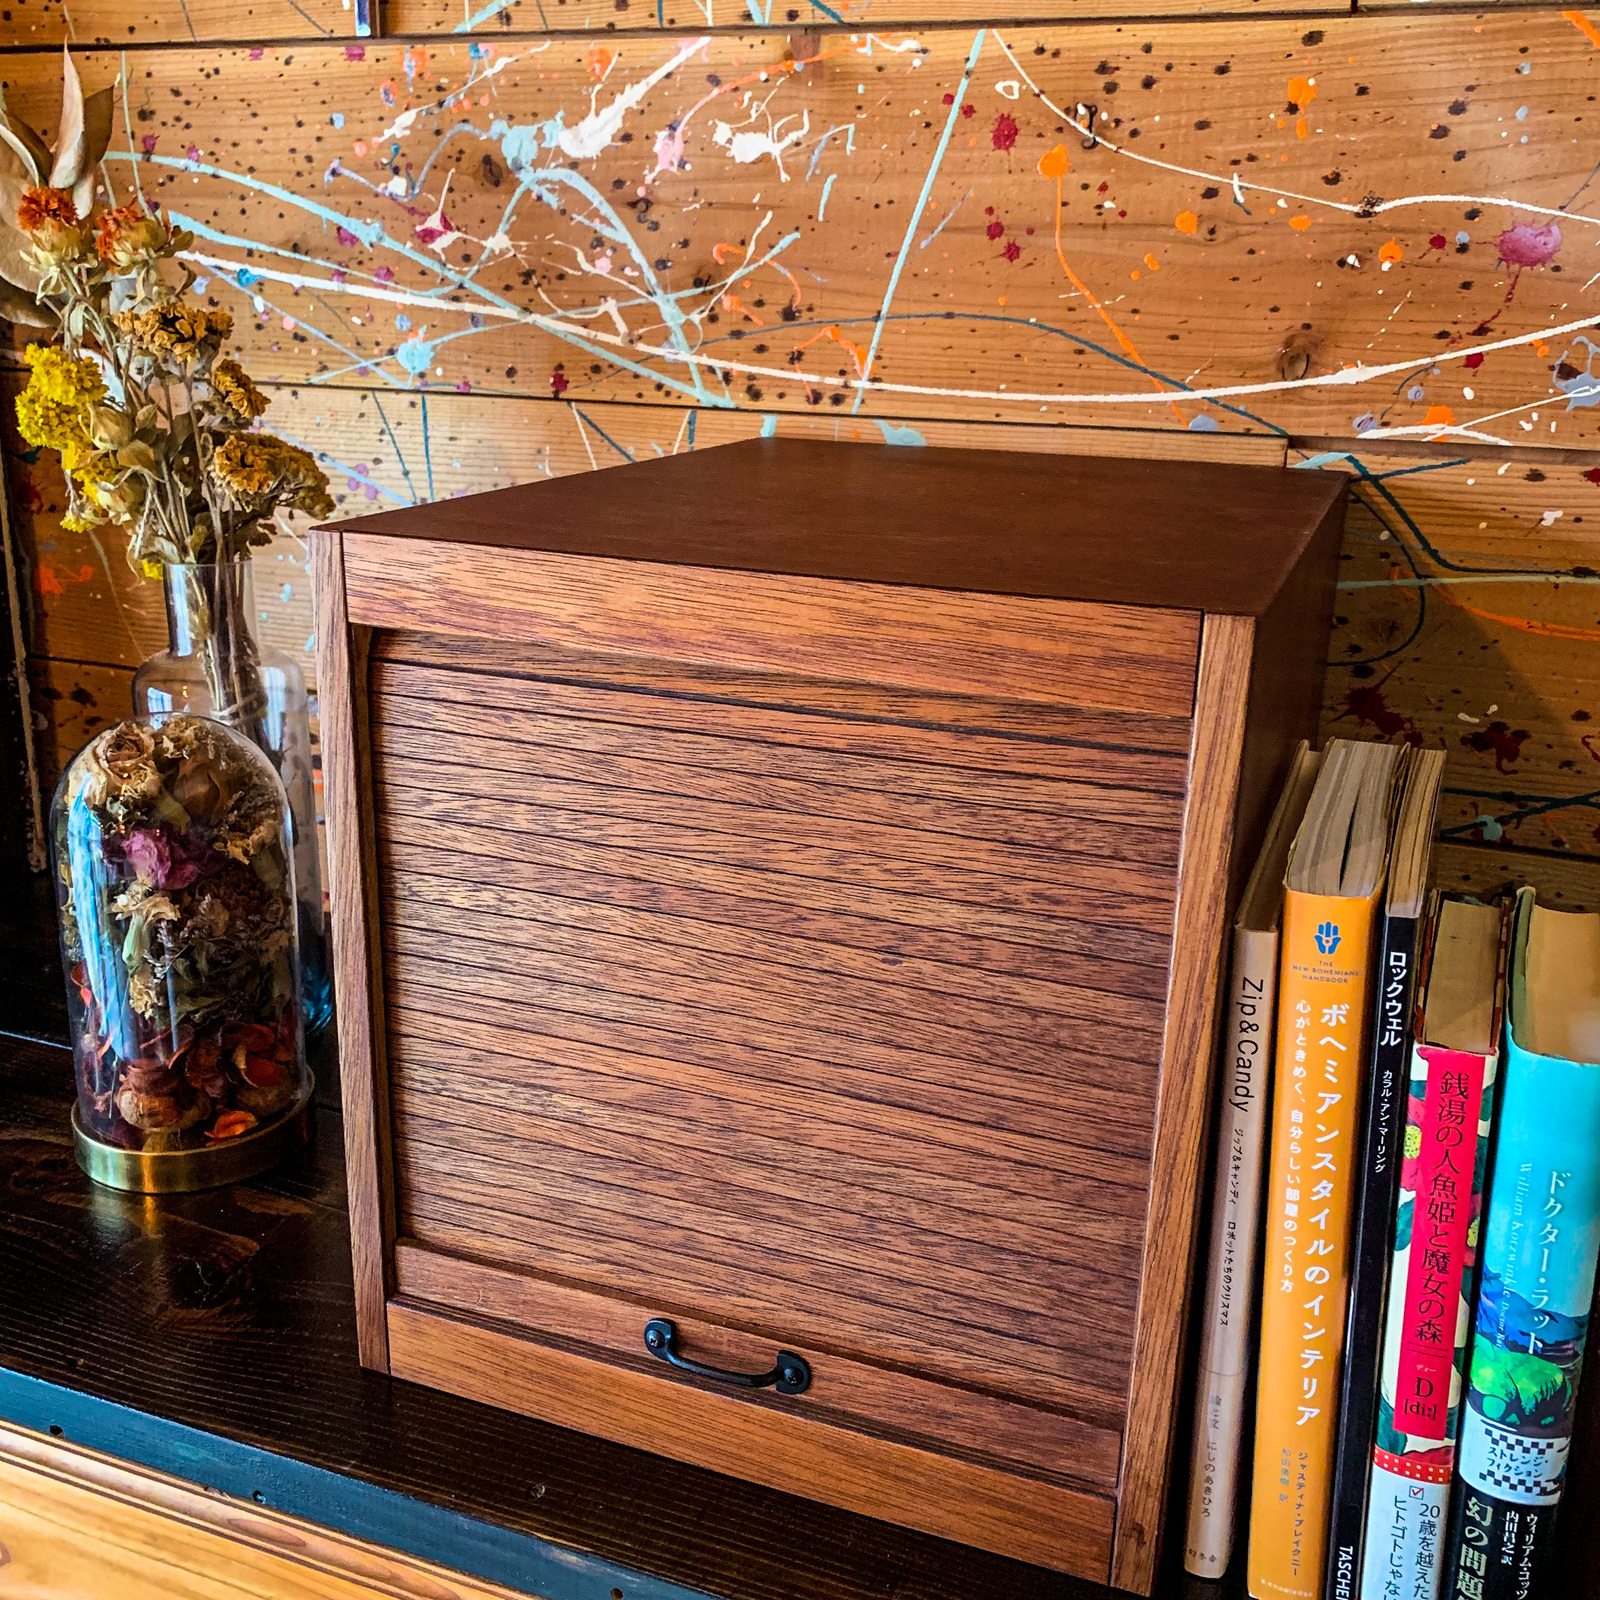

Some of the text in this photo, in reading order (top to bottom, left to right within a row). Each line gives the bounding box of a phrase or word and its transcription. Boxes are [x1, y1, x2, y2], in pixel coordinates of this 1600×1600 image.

[1292, 964, 1360, 977] NEW BOHEMIANS
[1302, 974, 1348, 984] HANDBOOK
[1380, 951, 1408, 1047] ロックウェル
[1374, 1069, 1394, 1174] カラル・アン・マーリング
[1295, 1003, 1350, 1426] ボヘミアンスタイルのインテリア
[1415, 1070, 1470, 1344] 銭湯の人魚姫と魔女の森
[1513, 1162, 1533, 1213] William
[1219, 1221, 1237, 1326] ロボットたちのクリスマス
[1528, 1170, 1572, 1355] ドクター・ラット
[1414, 1376, 1434, 1398] D
[1486, 1457, 1543, 1479] フィクション
[1456, 1496, 1494, 1600] 幻の問題
